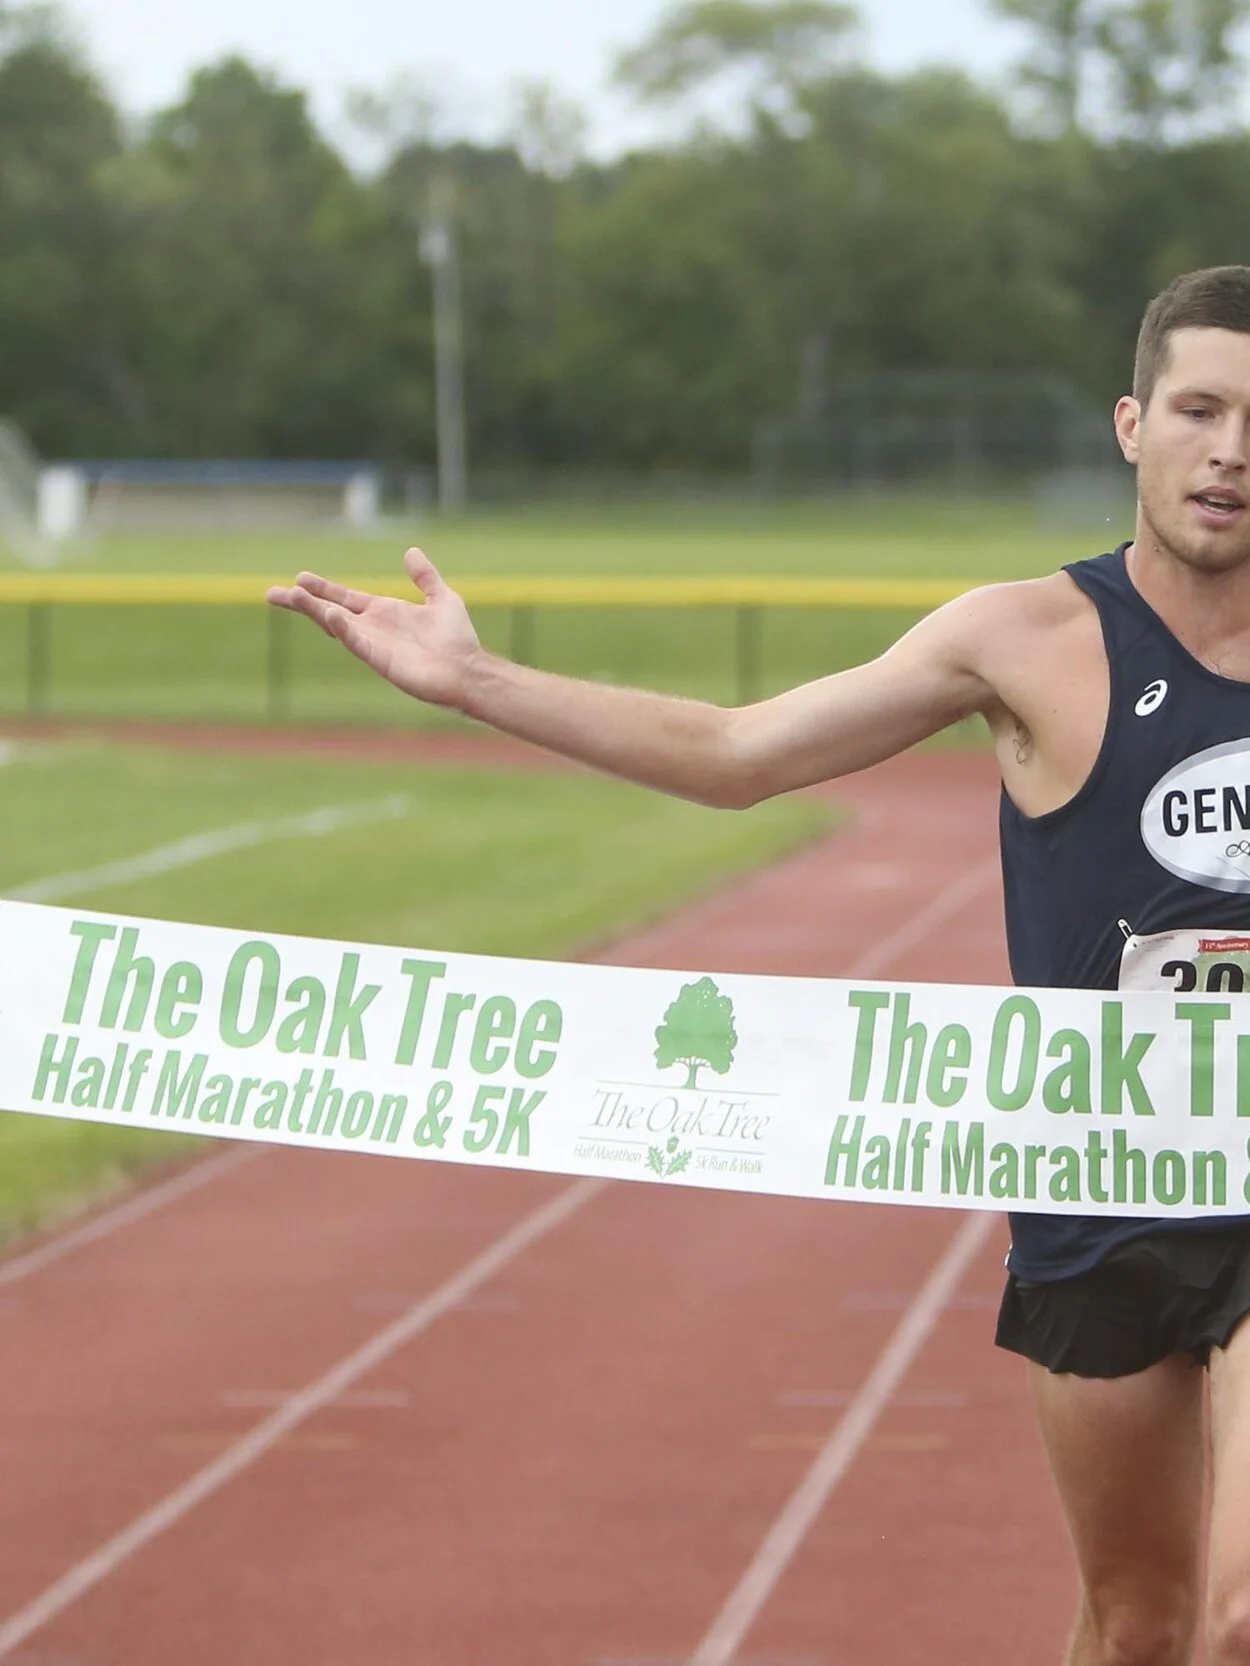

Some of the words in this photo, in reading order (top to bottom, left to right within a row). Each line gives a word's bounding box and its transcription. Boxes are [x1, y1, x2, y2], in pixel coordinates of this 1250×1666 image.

[63, 919, 202, 1038] The
[219, 940, 382, 1060] Oak
[395, 959, 564, 1079] Tree
[31, 1033, 152, 1113] Half
[151, 1049, 408, 1144] Marathon
[413, 1080, 453, 1149] &
[463, 1085, 547, 1156] 5K
[848, 990, 972, 1108] The
[986, 994, 1156, 1116] Oak
[574, 1143, 595, 1159] Half
[594, 1145, 642, 1164] Marathon
[708, 1156, 728, 1170] Run
[737, 1158, 763, 1174] Walk
[590, 1088, 645, 1129] The
[646, 1096, 713, 1135] Oak
[712, 1099, 771, 1141] Tree
[824, 1115, 932, 1192] Half
[940, 1120, 1227, 1207] Marathon
